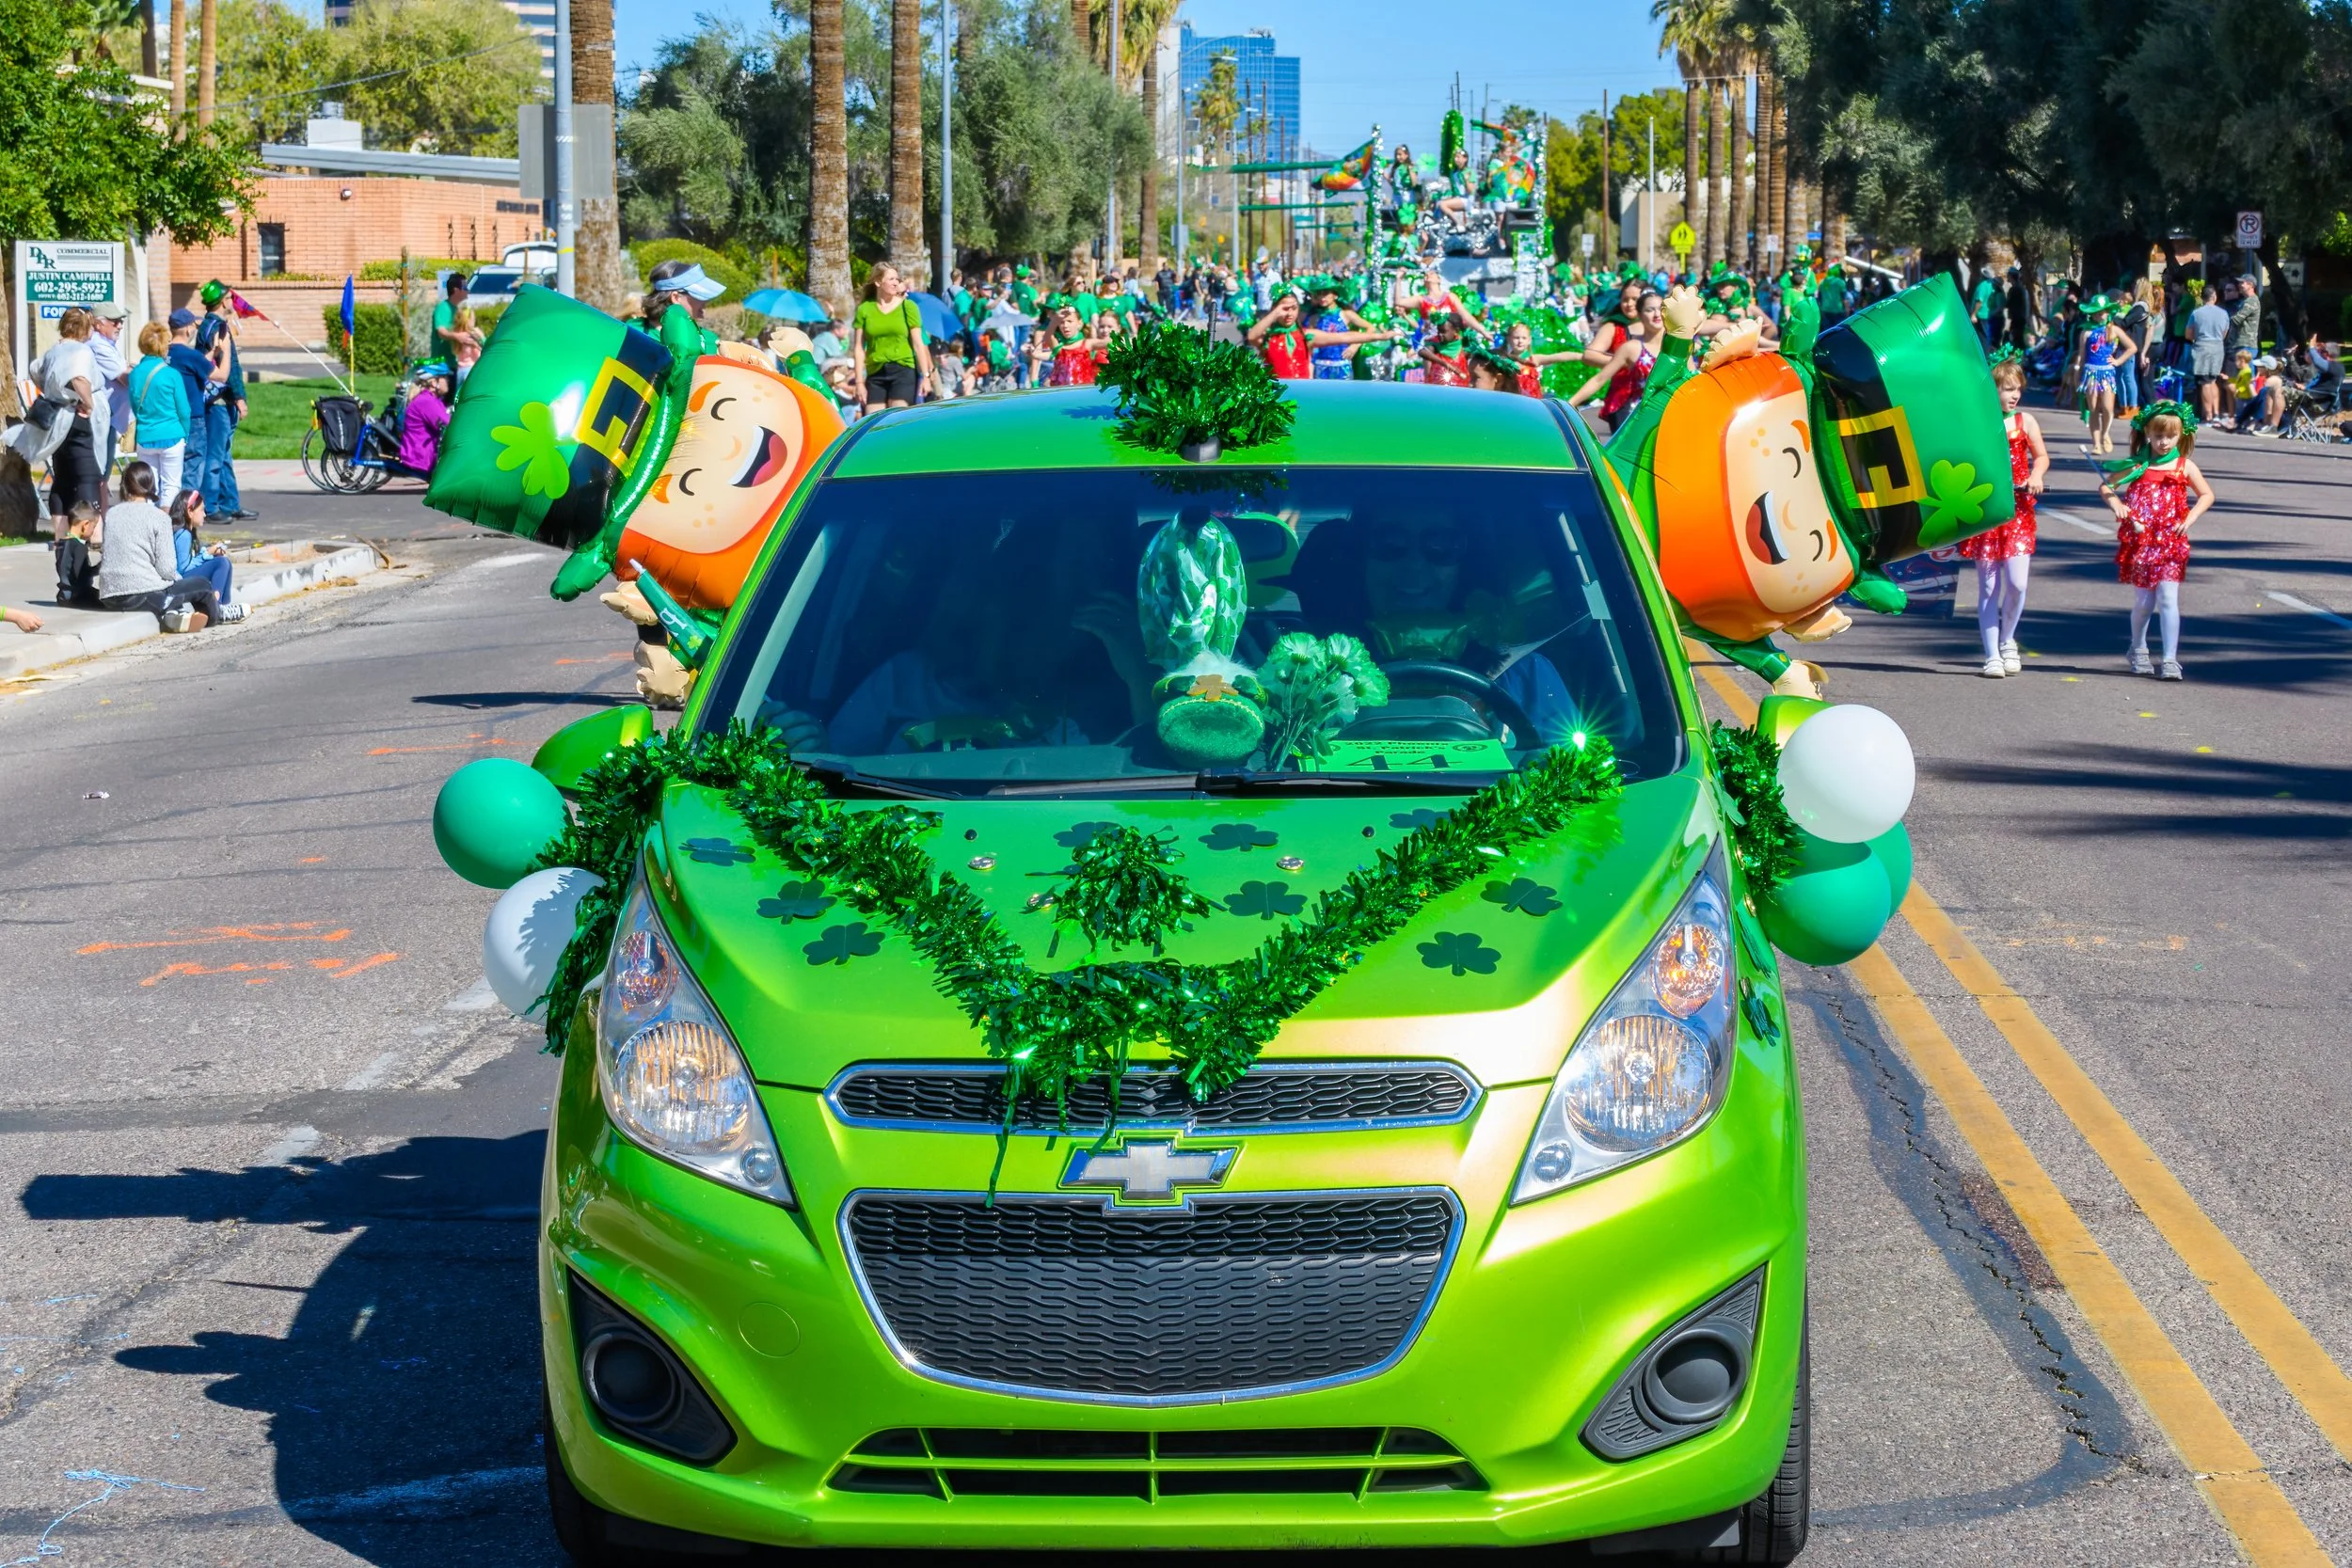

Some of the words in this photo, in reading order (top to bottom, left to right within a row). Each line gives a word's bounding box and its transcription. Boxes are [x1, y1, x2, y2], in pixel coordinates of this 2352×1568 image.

[28, 272, 61, 281] JUSTIN
[62, 272, 112, 282] CAMPBELL
[34, 281, 108, 293] 602-295-5922
[1346, 754, 1464, 770] 44
